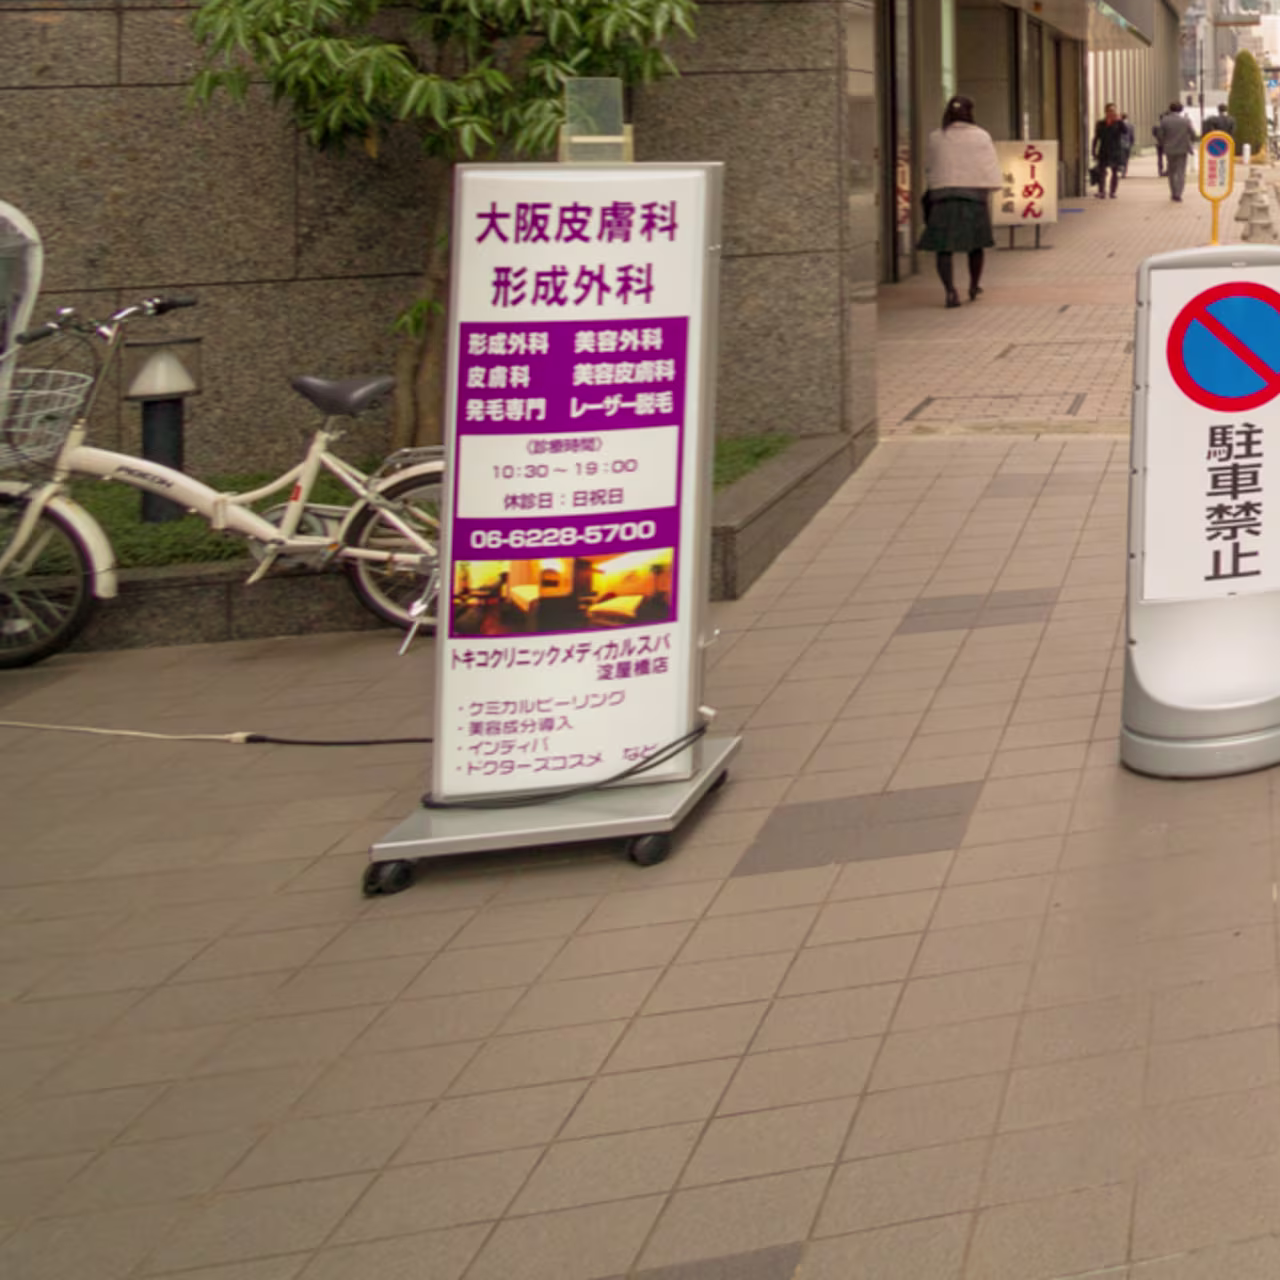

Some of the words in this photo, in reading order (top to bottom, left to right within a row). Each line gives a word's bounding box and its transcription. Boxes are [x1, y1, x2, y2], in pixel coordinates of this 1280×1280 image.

[1022, 144, 1044, 219] らーめん
[475, 200, 679, 244] 大阪皮膚科
[491, 263, 655, 308] 形成外科
[468, 331, 549, 356] 形成外科
[574, 327, 663, 354] 美容外科
[466, 365, 531, 389] 皮膚科
[572, 358, 676, 387] 美容皮膚科
[465, 396, 547, 422] 発毛専門
[569, 390, 674, 419] レーザー脱毛
[1204, 422, 1264, 582] 駐車禁止
[470, 520, 657, 549] 06-6228-5700
[596, 657, 670, 681] 淀屋橋店
